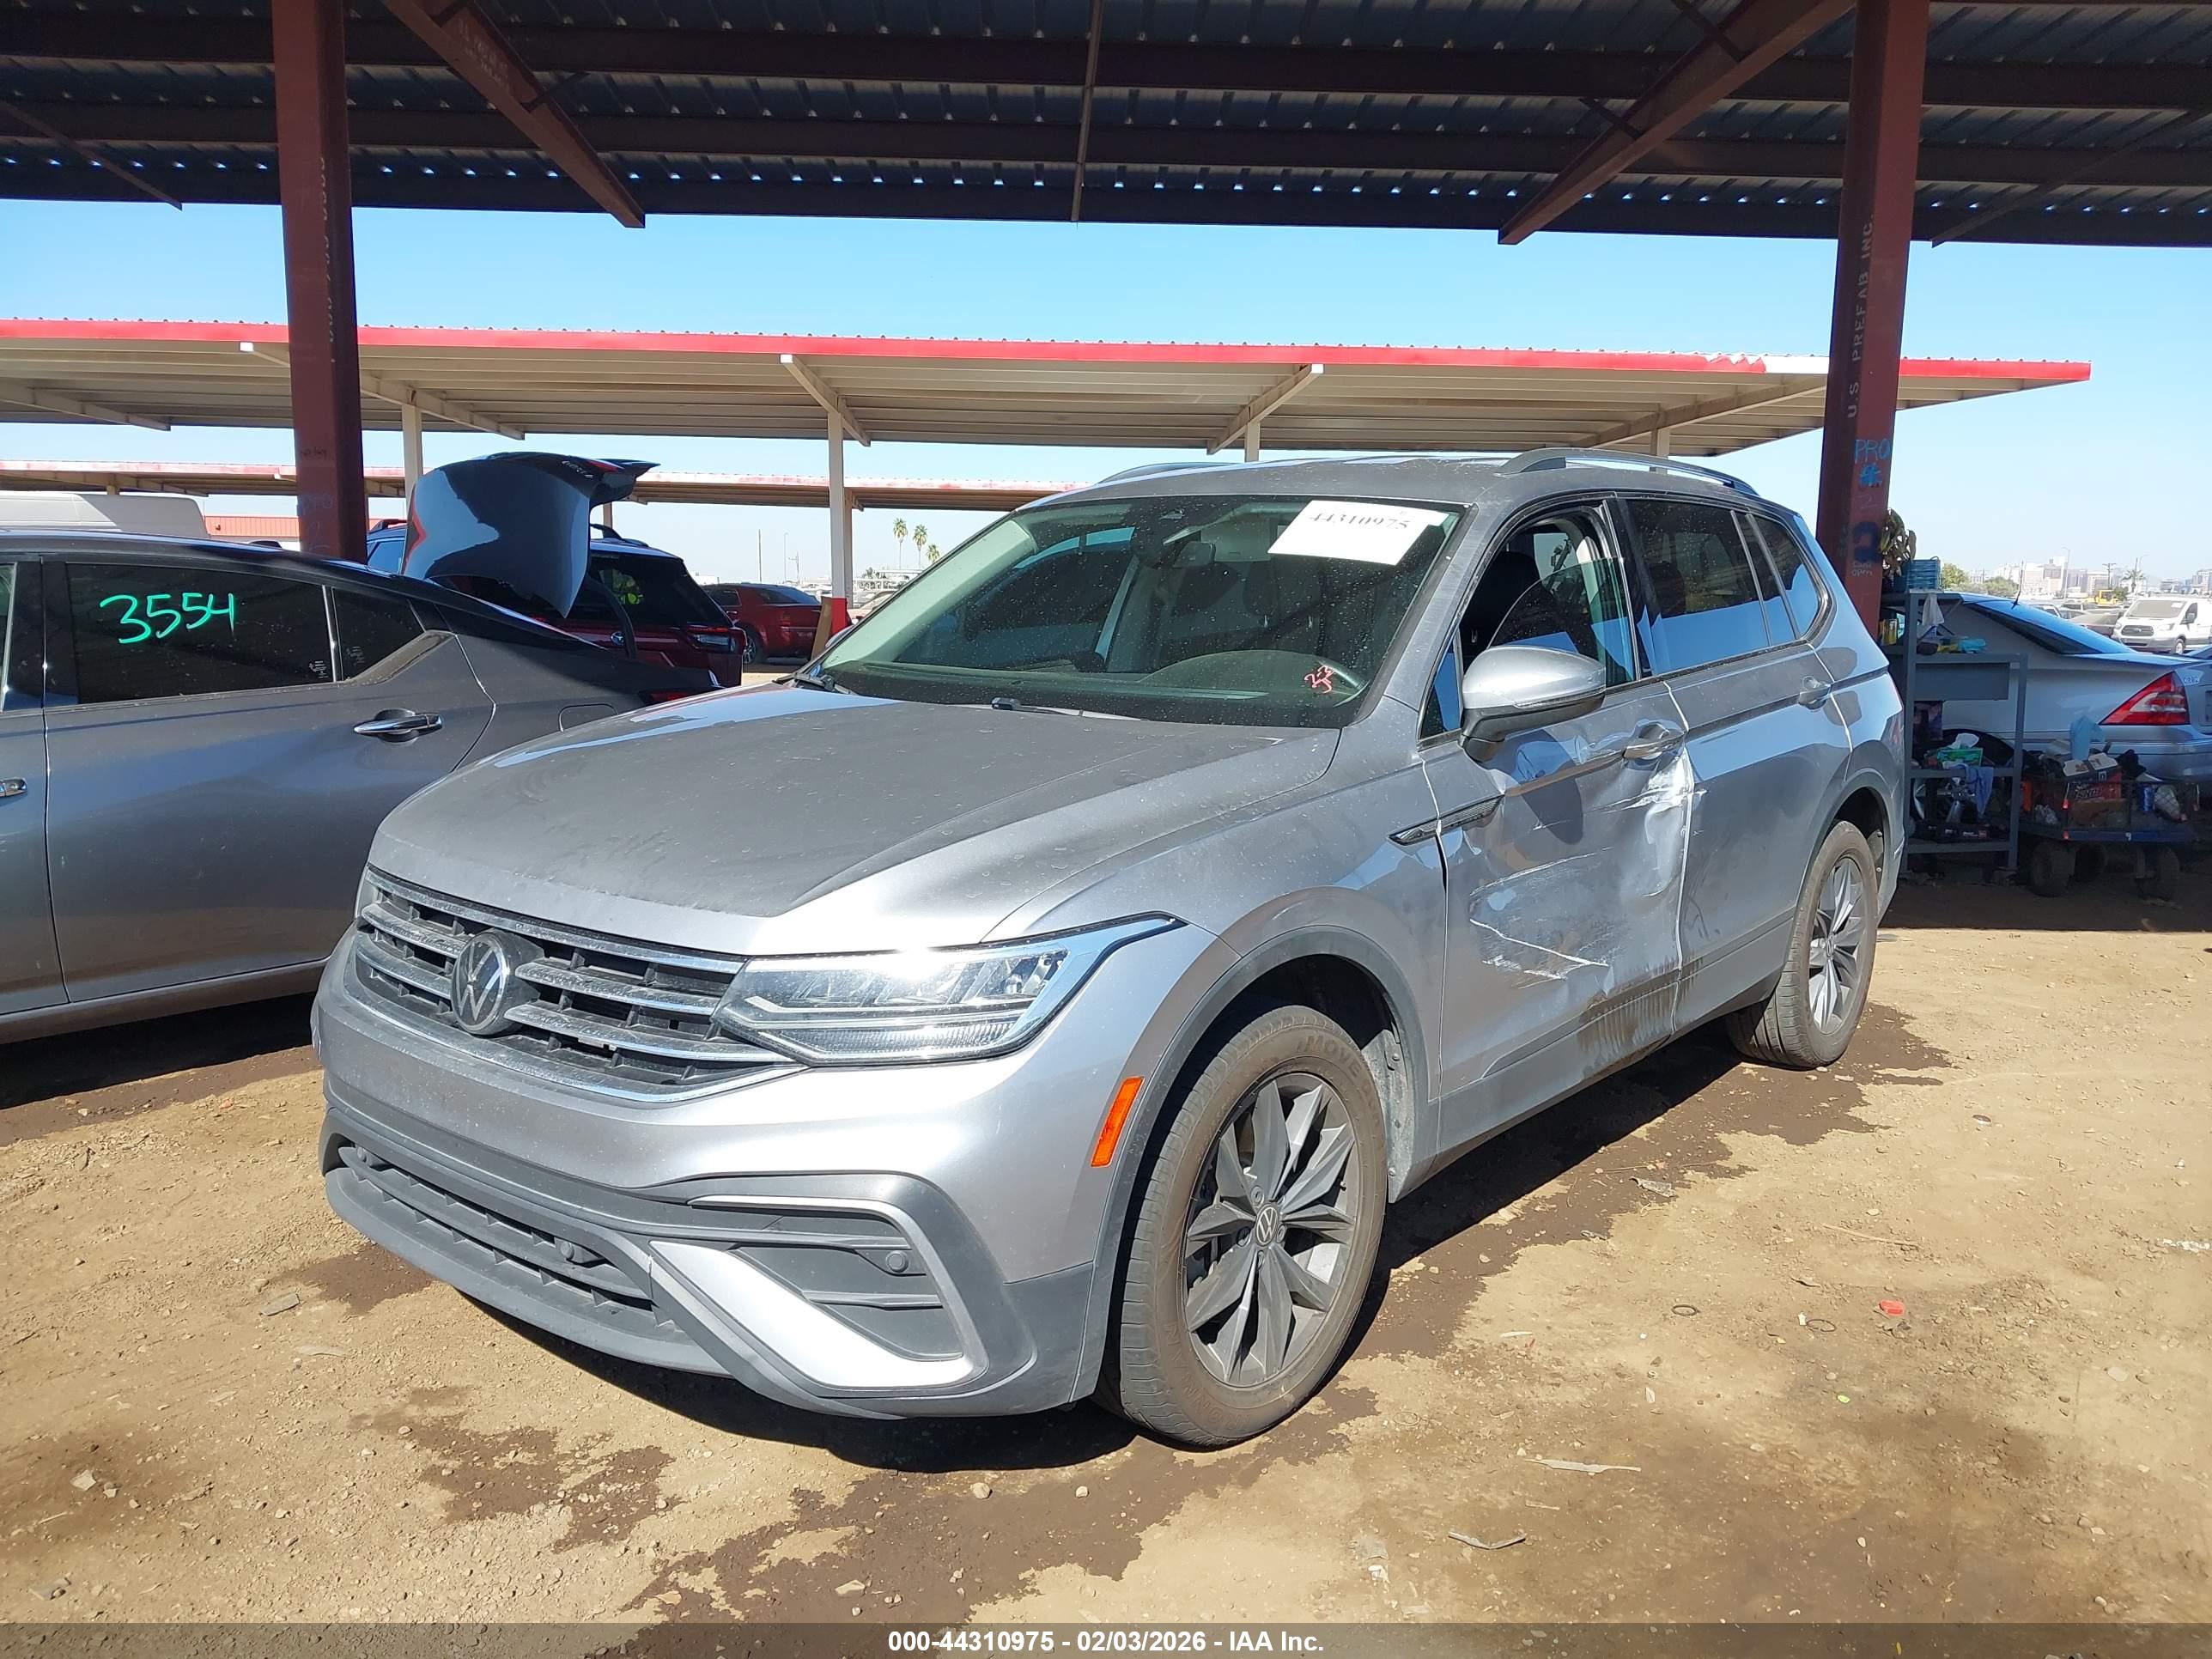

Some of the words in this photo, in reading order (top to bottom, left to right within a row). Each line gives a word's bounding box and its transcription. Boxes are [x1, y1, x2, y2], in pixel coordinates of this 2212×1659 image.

[1852, 271, 1869, 362] PREFAB
[1854, 439, 1891, 464] PRO
[1308, 513, 1411, 530] 44310975
[100, 592, 234, 643] 3554
